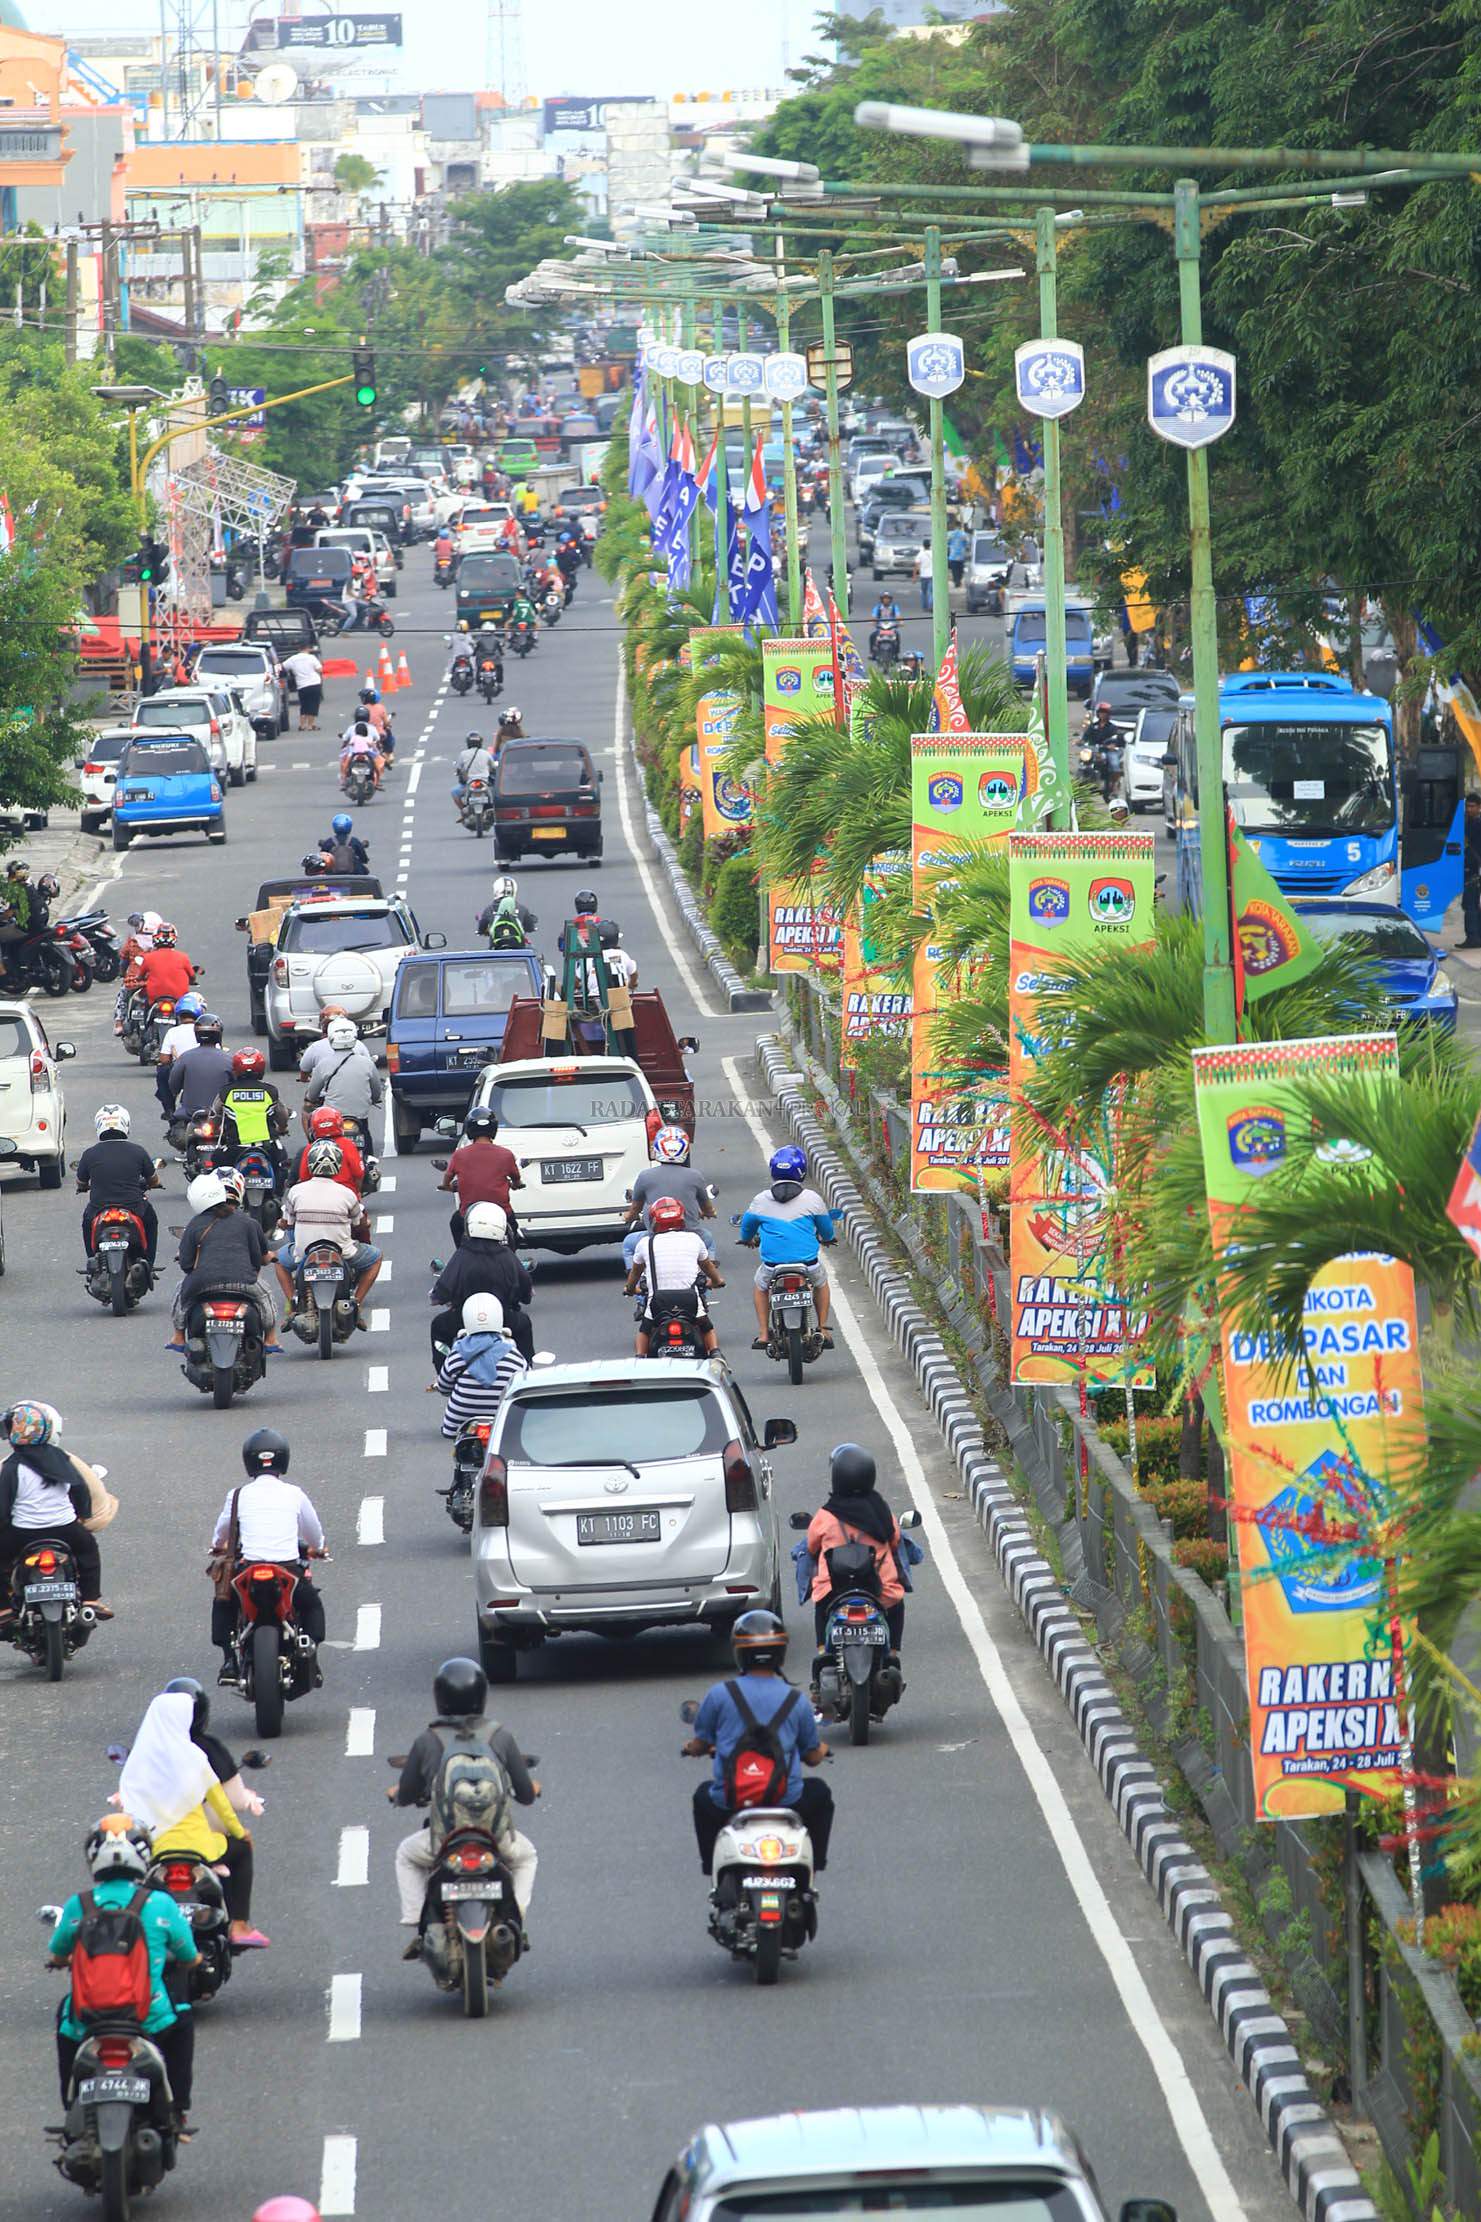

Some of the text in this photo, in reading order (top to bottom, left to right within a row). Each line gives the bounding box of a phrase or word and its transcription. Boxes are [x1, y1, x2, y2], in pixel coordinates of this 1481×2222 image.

[1347, 842, 1361, 862] 5
[1094, 925, 1129, 933] APEKSI
[233, 1091, 264, 1101] POLISI
[544, 1162, 599, 1175] KT 1622 FF
[1018, 1307, 1103, 1338] APEKSI
[1032, 1342, 1066, 1354] Tarakan,
[1067, 1342, 1077, 1353] 24
[1096, 1341, 1111, 1353] Juli
[1299, 1365, 1345, 1388] DAN
[1251, 1391, 1398, 1424] ROMBONGAN
[580, 1513, 657, 1533] KT 1103 FC
[1260, 1660, 1413, 1706] RAKERN
[1262, 1705, 1379, 1754] APEKSI
[1284, 1758, 1330, 1774] Tarakan,
[1332, 1756, 1346, 1770] 24
[1357, 1755, 1371, 1769] 28
[1374, 1752, 1395, 1768] Juli
